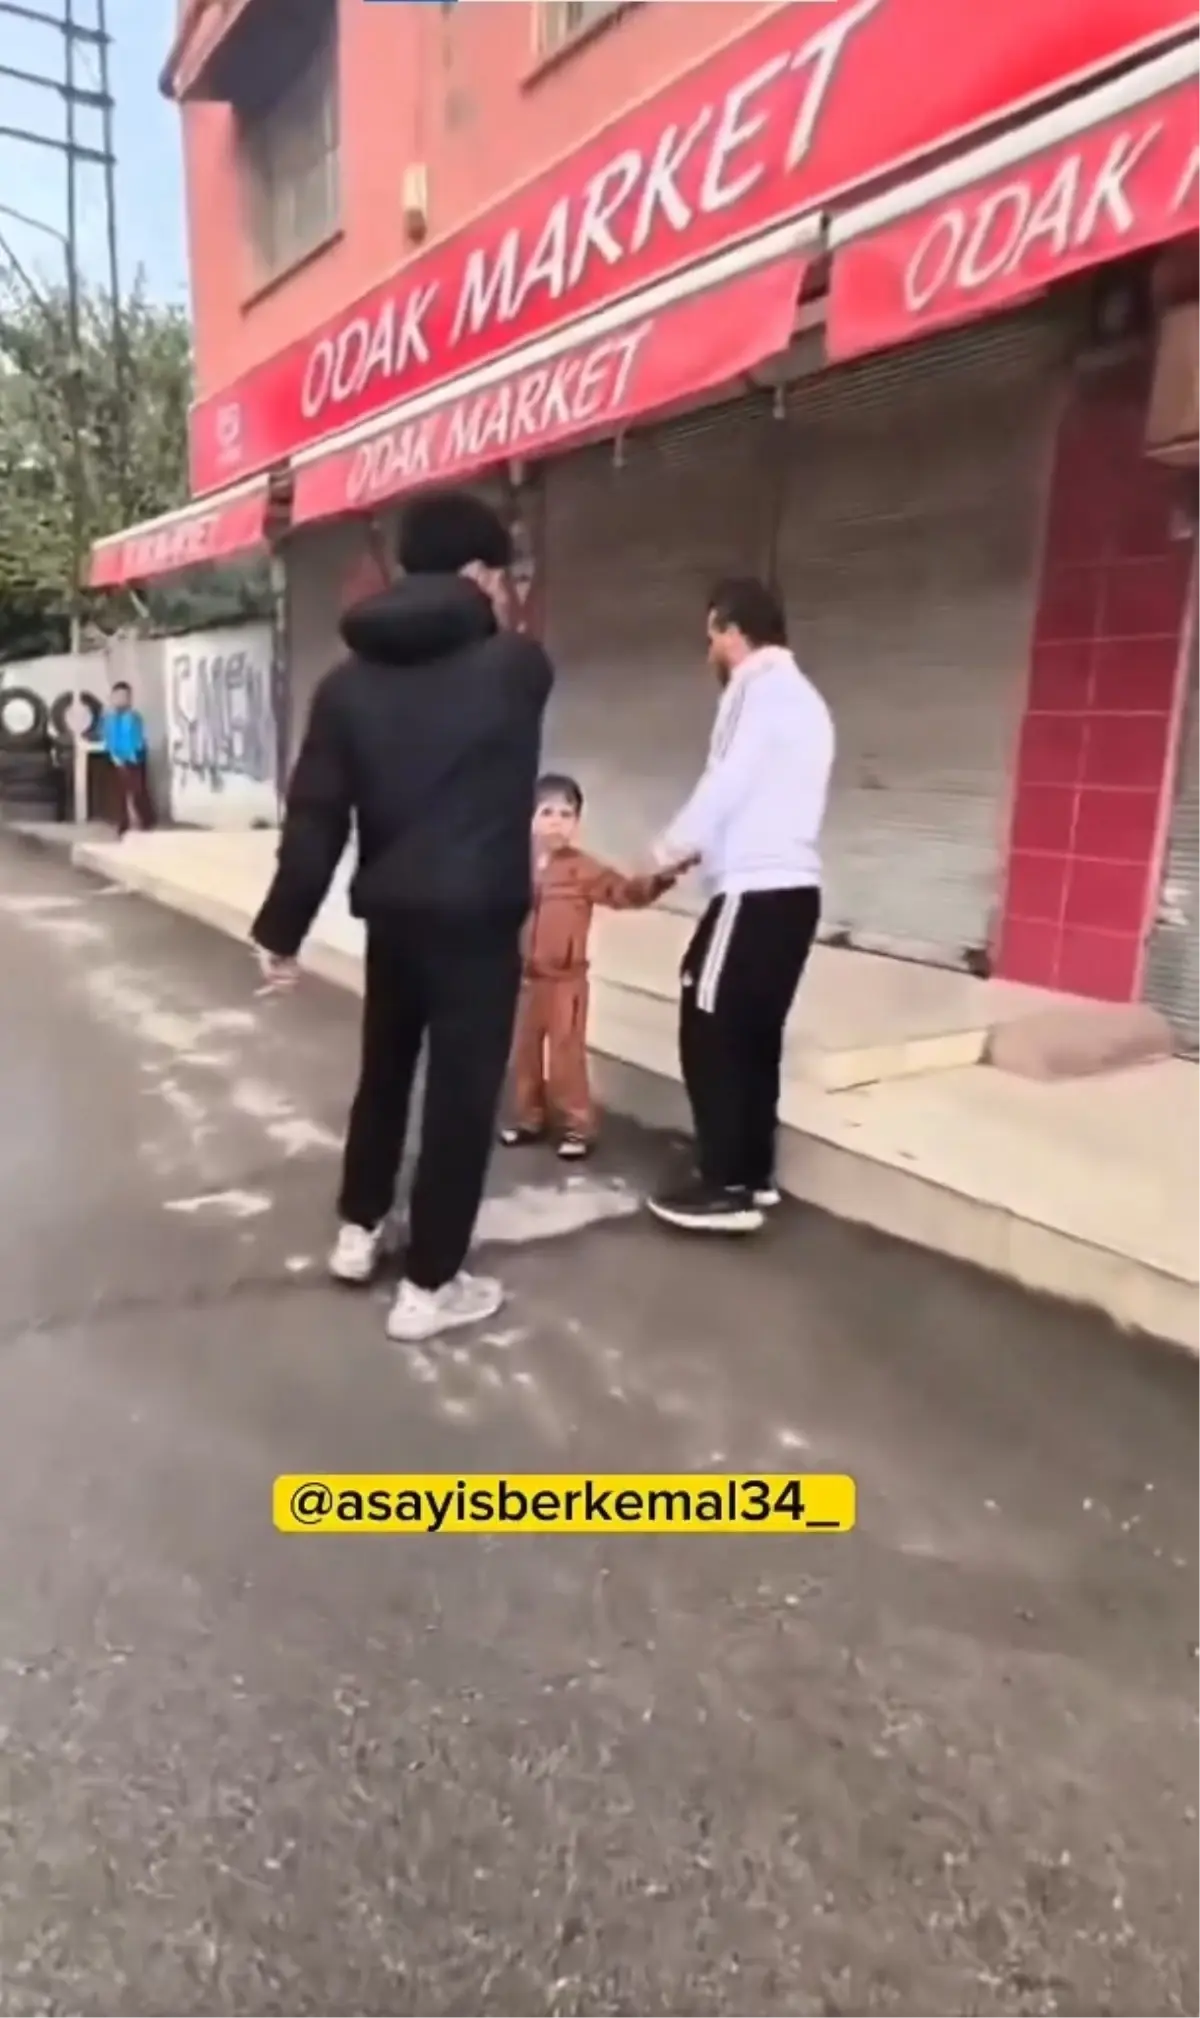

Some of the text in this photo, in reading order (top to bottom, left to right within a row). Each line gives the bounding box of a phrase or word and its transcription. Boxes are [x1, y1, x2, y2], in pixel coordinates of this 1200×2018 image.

[302, 0, 883, 418] ODAK MARKET
[905, 119, 1163, 312] ODAK
[346, 319, 655, 501] ODAK MARKET
